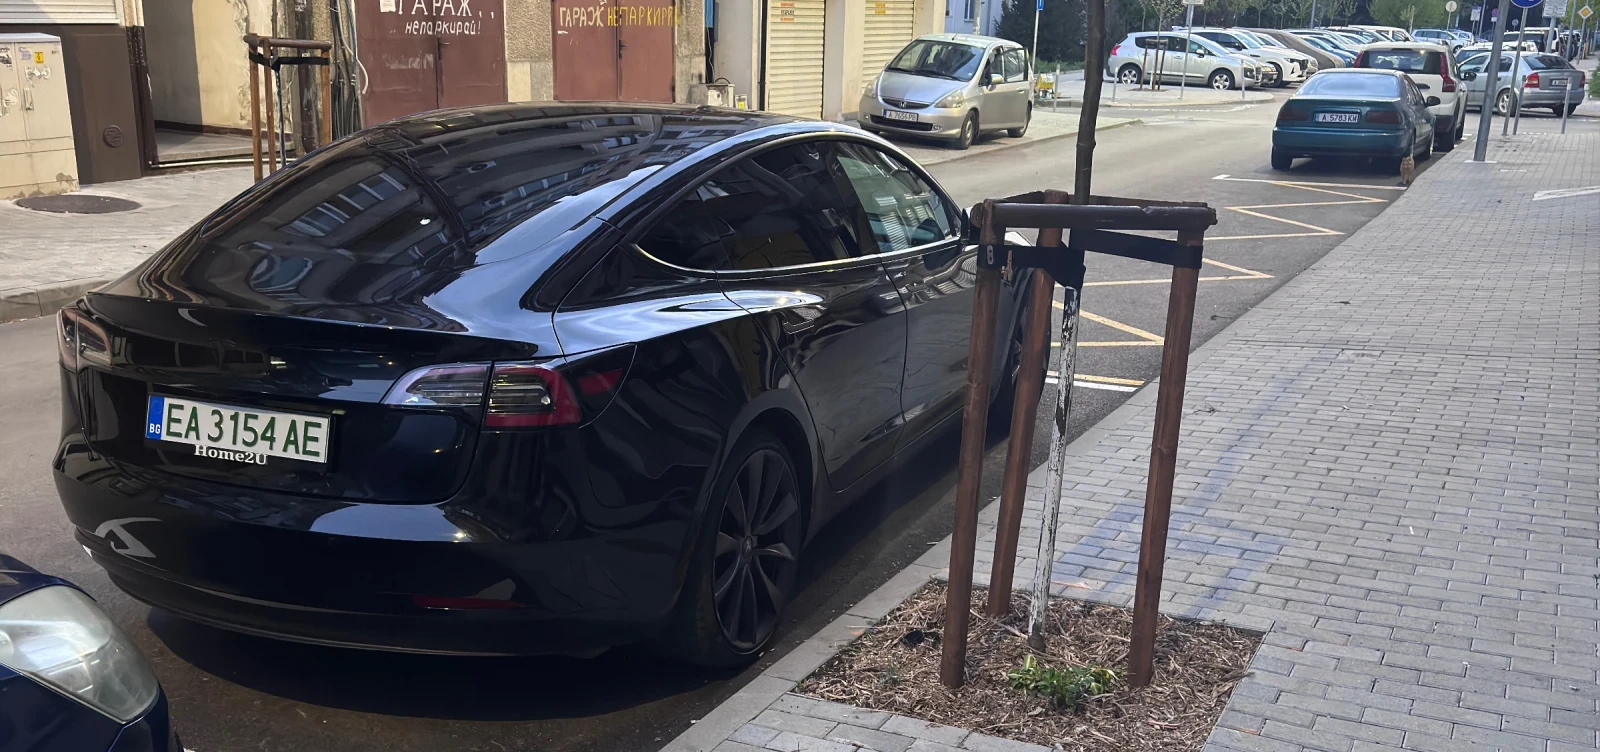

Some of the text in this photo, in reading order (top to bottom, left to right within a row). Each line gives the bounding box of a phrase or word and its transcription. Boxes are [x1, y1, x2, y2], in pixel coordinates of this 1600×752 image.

[559, 6, 604, 27] ГАРАЖ
[149, 423, 161, 434] BG
[165, 403, 322, 457] EA 3154 AE
[193, 444, 267, 465] Home2U
